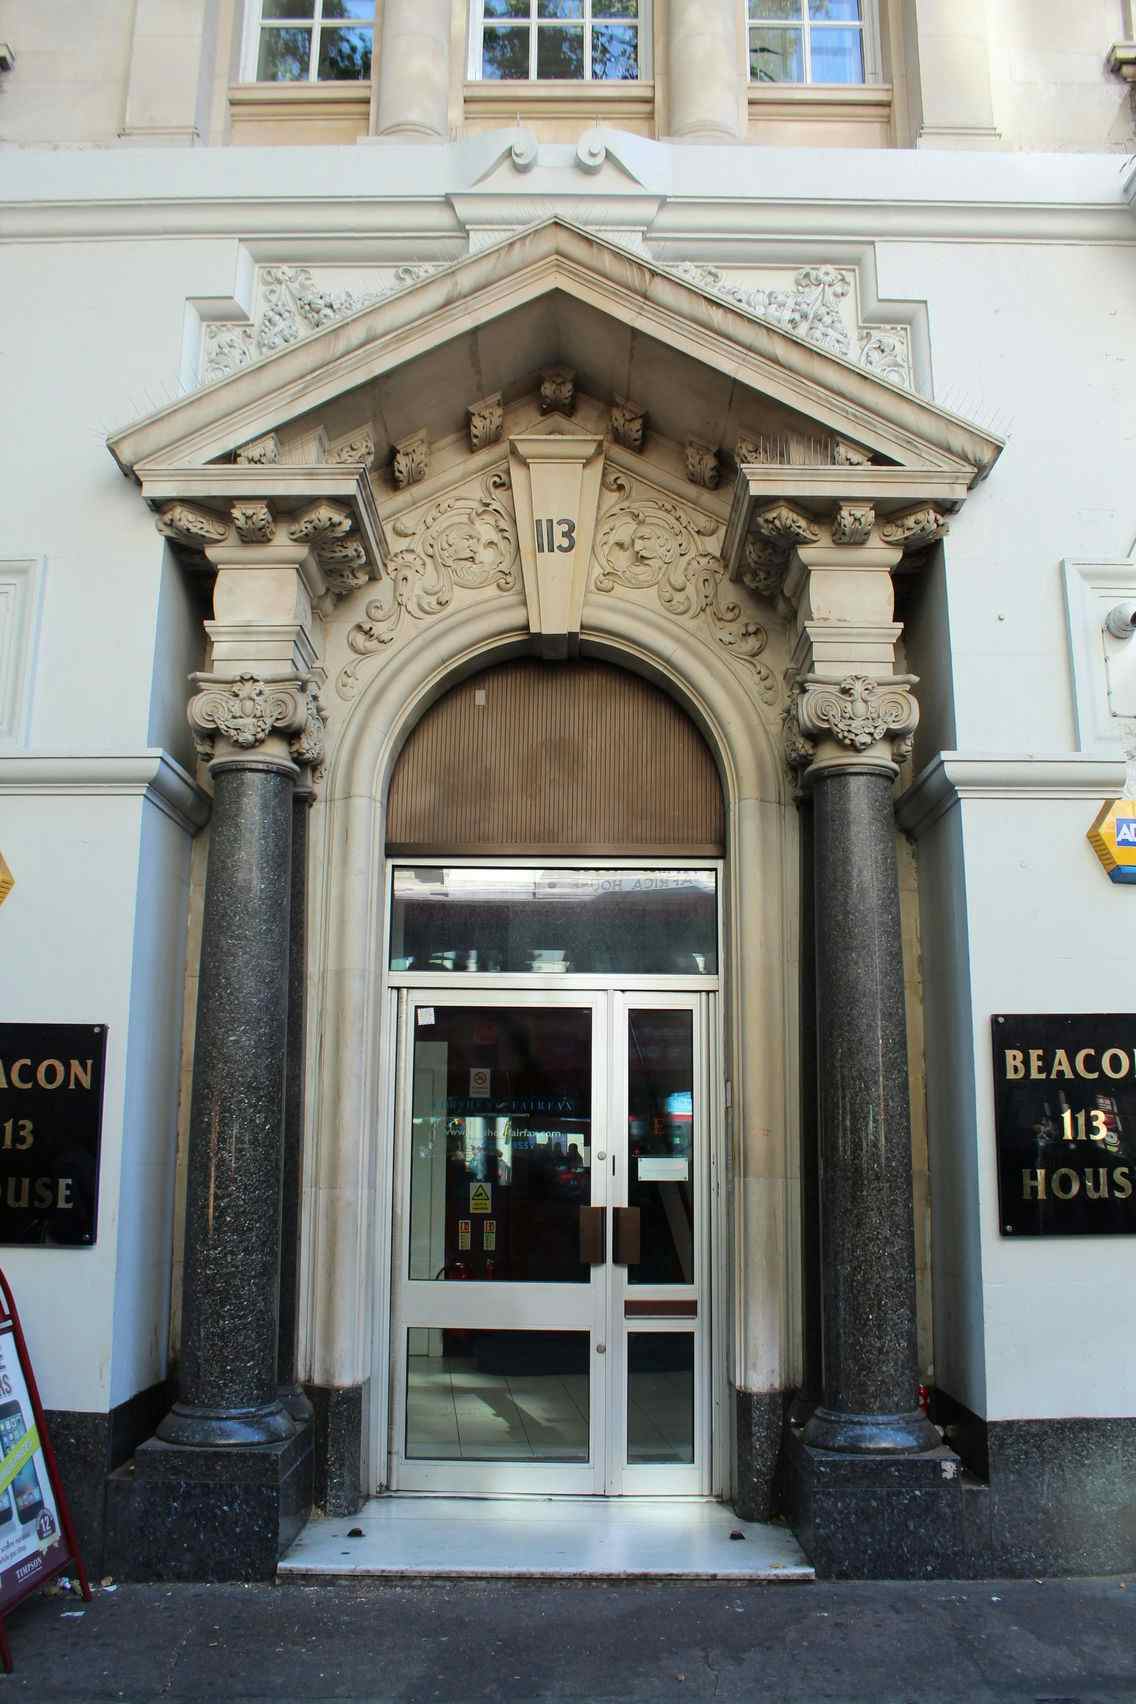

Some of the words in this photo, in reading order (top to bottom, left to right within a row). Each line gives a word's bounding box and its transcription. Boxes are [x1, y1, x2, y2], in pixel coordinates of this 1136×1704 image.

[535, 518, 576, 553] 113
[1005, 1048, 1136, 1079] BEACO
[1061, 1109, 1107, 1140] 113
[0, 1177, 73, 1209] USE
